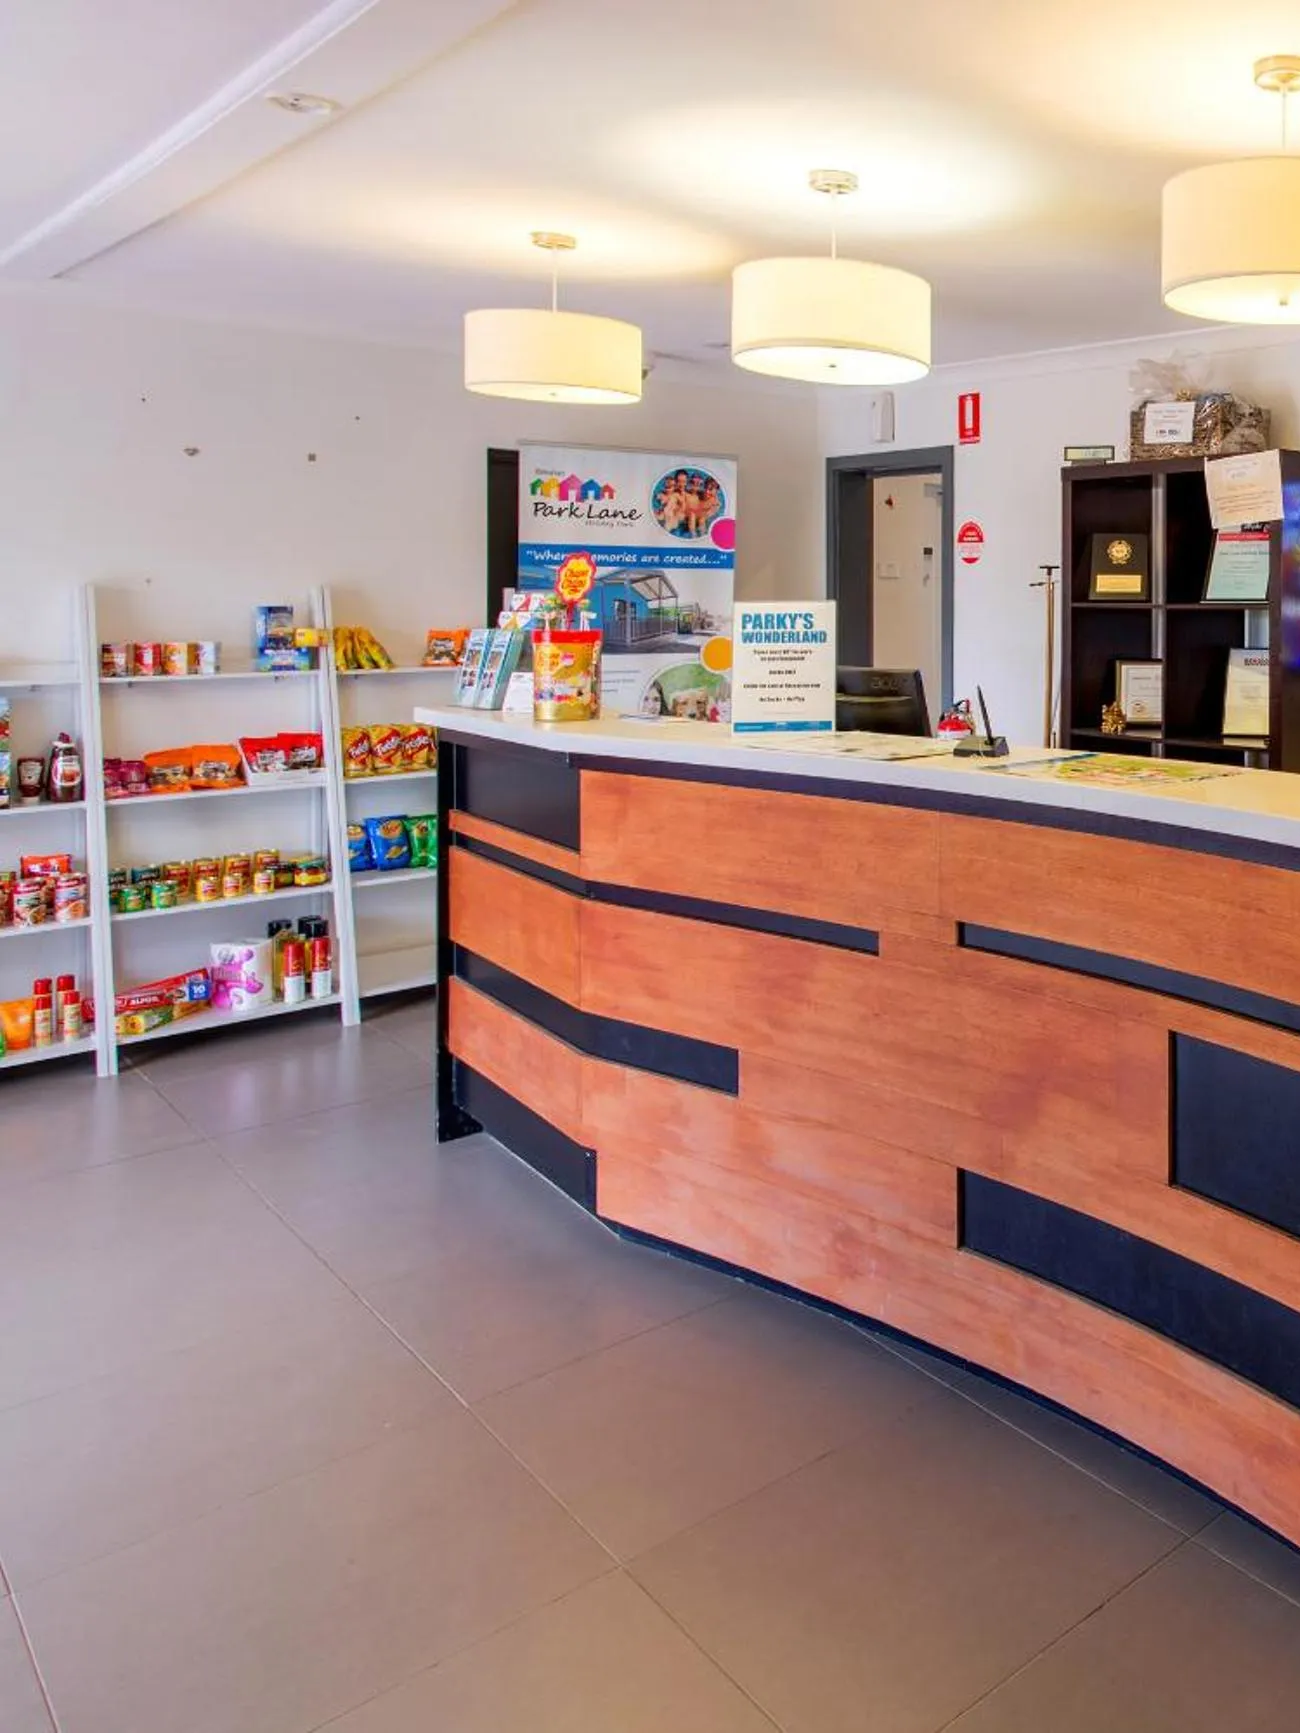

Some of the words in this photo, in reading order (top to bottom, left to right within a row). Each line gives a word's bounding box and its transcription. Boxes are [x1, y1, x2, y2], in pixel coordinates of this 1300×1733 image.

[533, 501, 584, 519] Park
[587, 503, 644, 521] Lane
[590, 551, 637, 562] emories
[641, 554, 660, 563] are
[741, 612, 814, 630] PARKY'S
[741, 630, 827, 643] WONDERLAND
